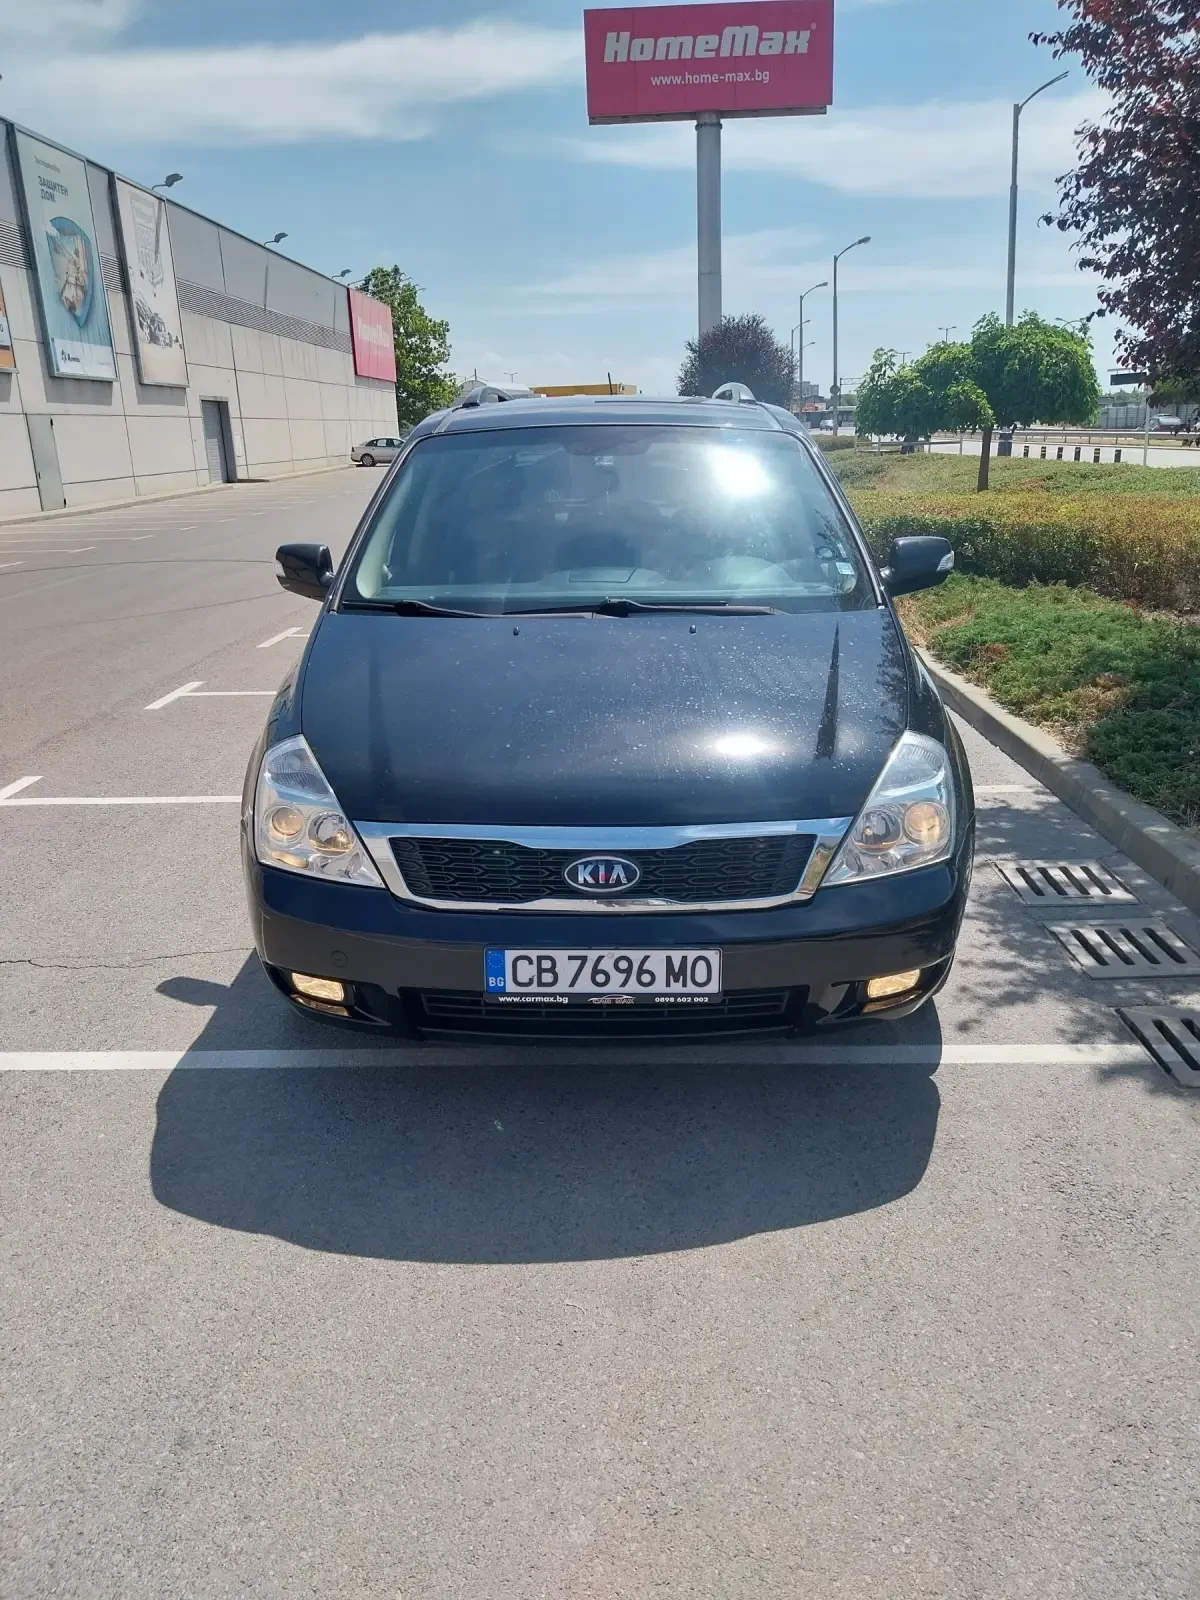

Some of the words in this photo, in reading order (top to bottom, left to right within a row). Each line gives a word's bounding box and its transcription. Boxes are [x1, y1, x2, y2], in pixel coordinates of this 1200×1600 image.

[603, 25, 811, 63] HomeMax
[650, 69, 770, 86] www.home-max.bg
[577, 864, 628, 884] KIA
[511, 955, 559, 988] CB
[567, 955, 656, 988] 7696
[665, 955, 713, 988] MO
[488, 976, 505, 987] BG
[498, 995, 569, 1004] www.carmax.bg
